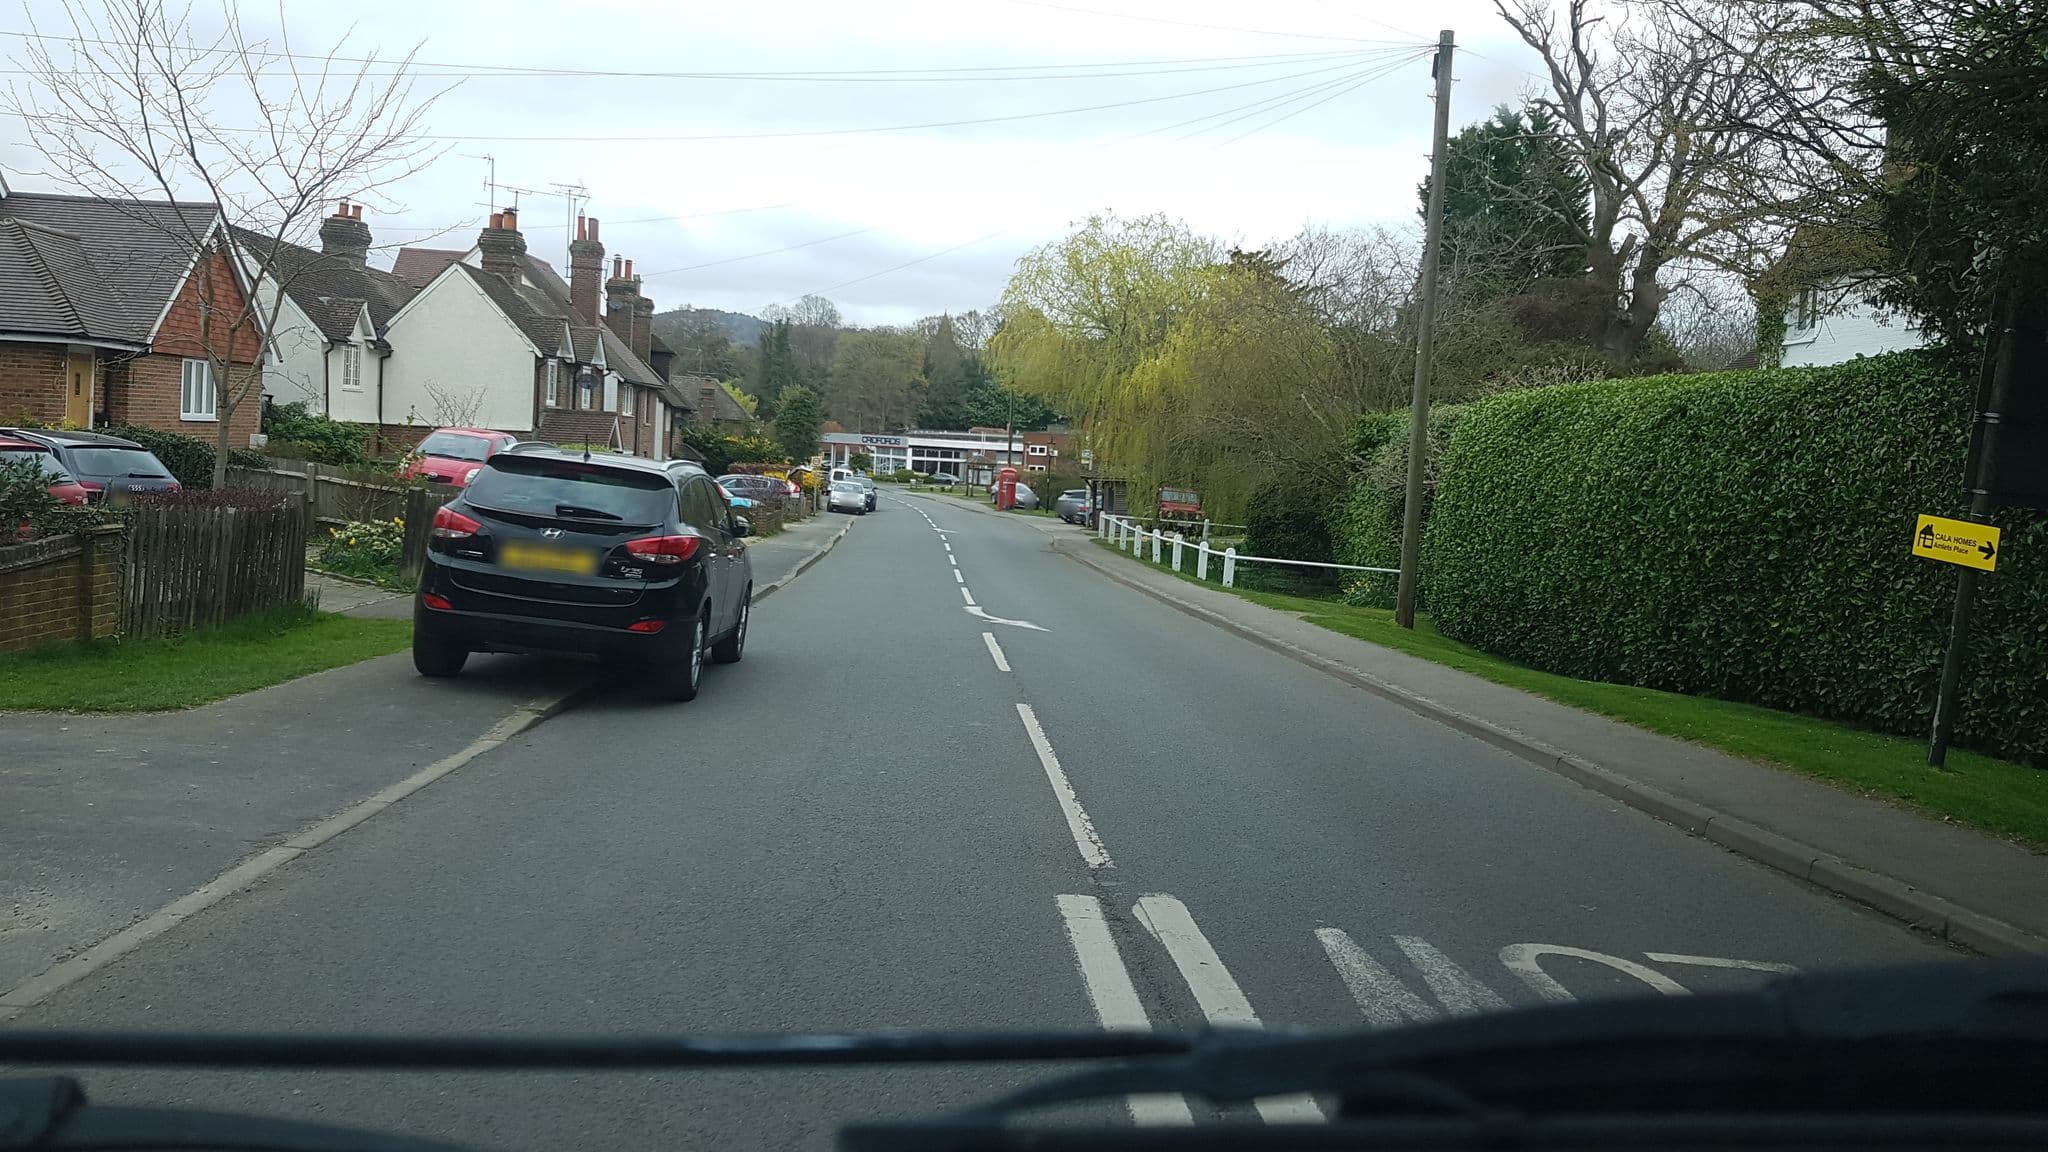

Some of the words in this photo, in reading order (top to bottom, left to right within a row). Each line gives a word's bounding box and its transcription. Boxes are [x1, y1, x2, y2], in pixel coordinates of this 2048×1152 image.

[1935, 533, 1952, 542] CALA
[1953, 536, 1977, 547] HOMES
[1953, 545, 1969, 554] Place
